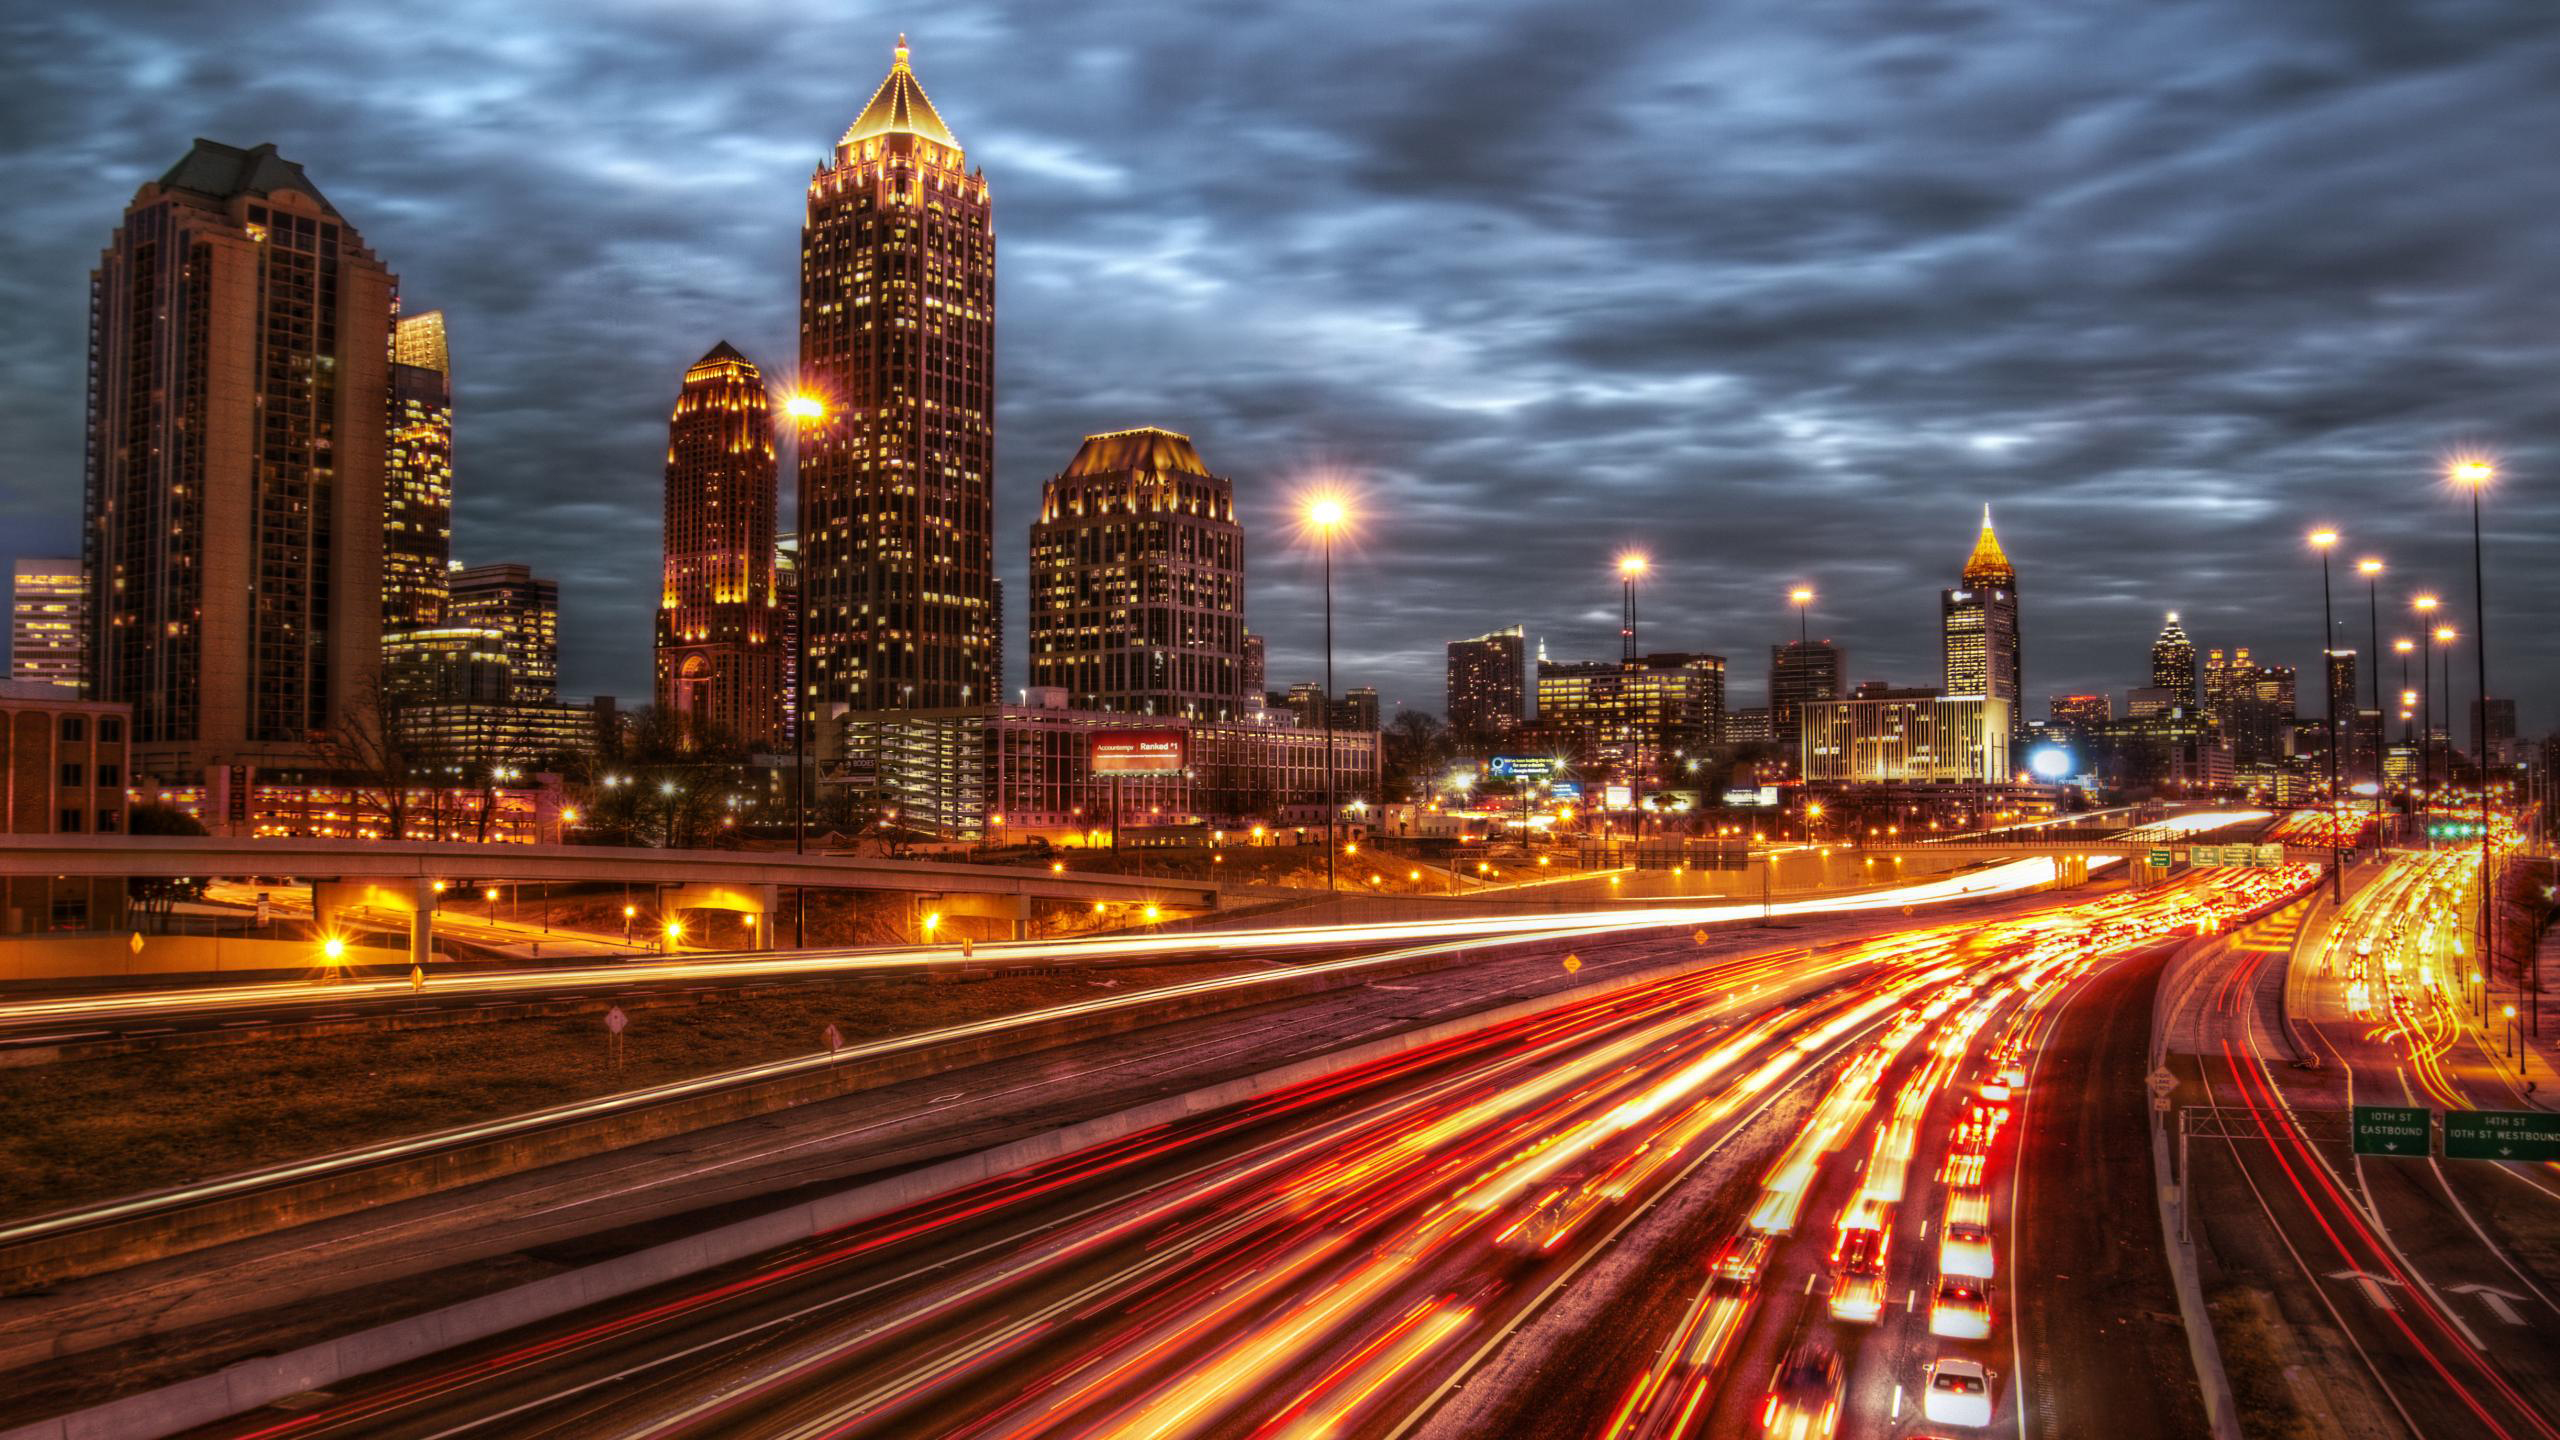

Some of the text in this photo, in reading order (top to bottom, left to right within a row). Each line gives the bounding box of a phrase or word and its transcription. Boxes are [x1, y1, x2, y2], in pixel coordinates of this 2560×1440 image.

[1140, 742, 1168, 750] Ranked
[2371, 1112, 2412, 1122] 10TH ST
[2485, 1116, 2526, 1127] 14TH ST
[2361, 1125, 2423, 1136] EASTBOUND
[2450, 1129, 2475, 1139] 10TH
[2479, 1130, 2492, 1139] ST
